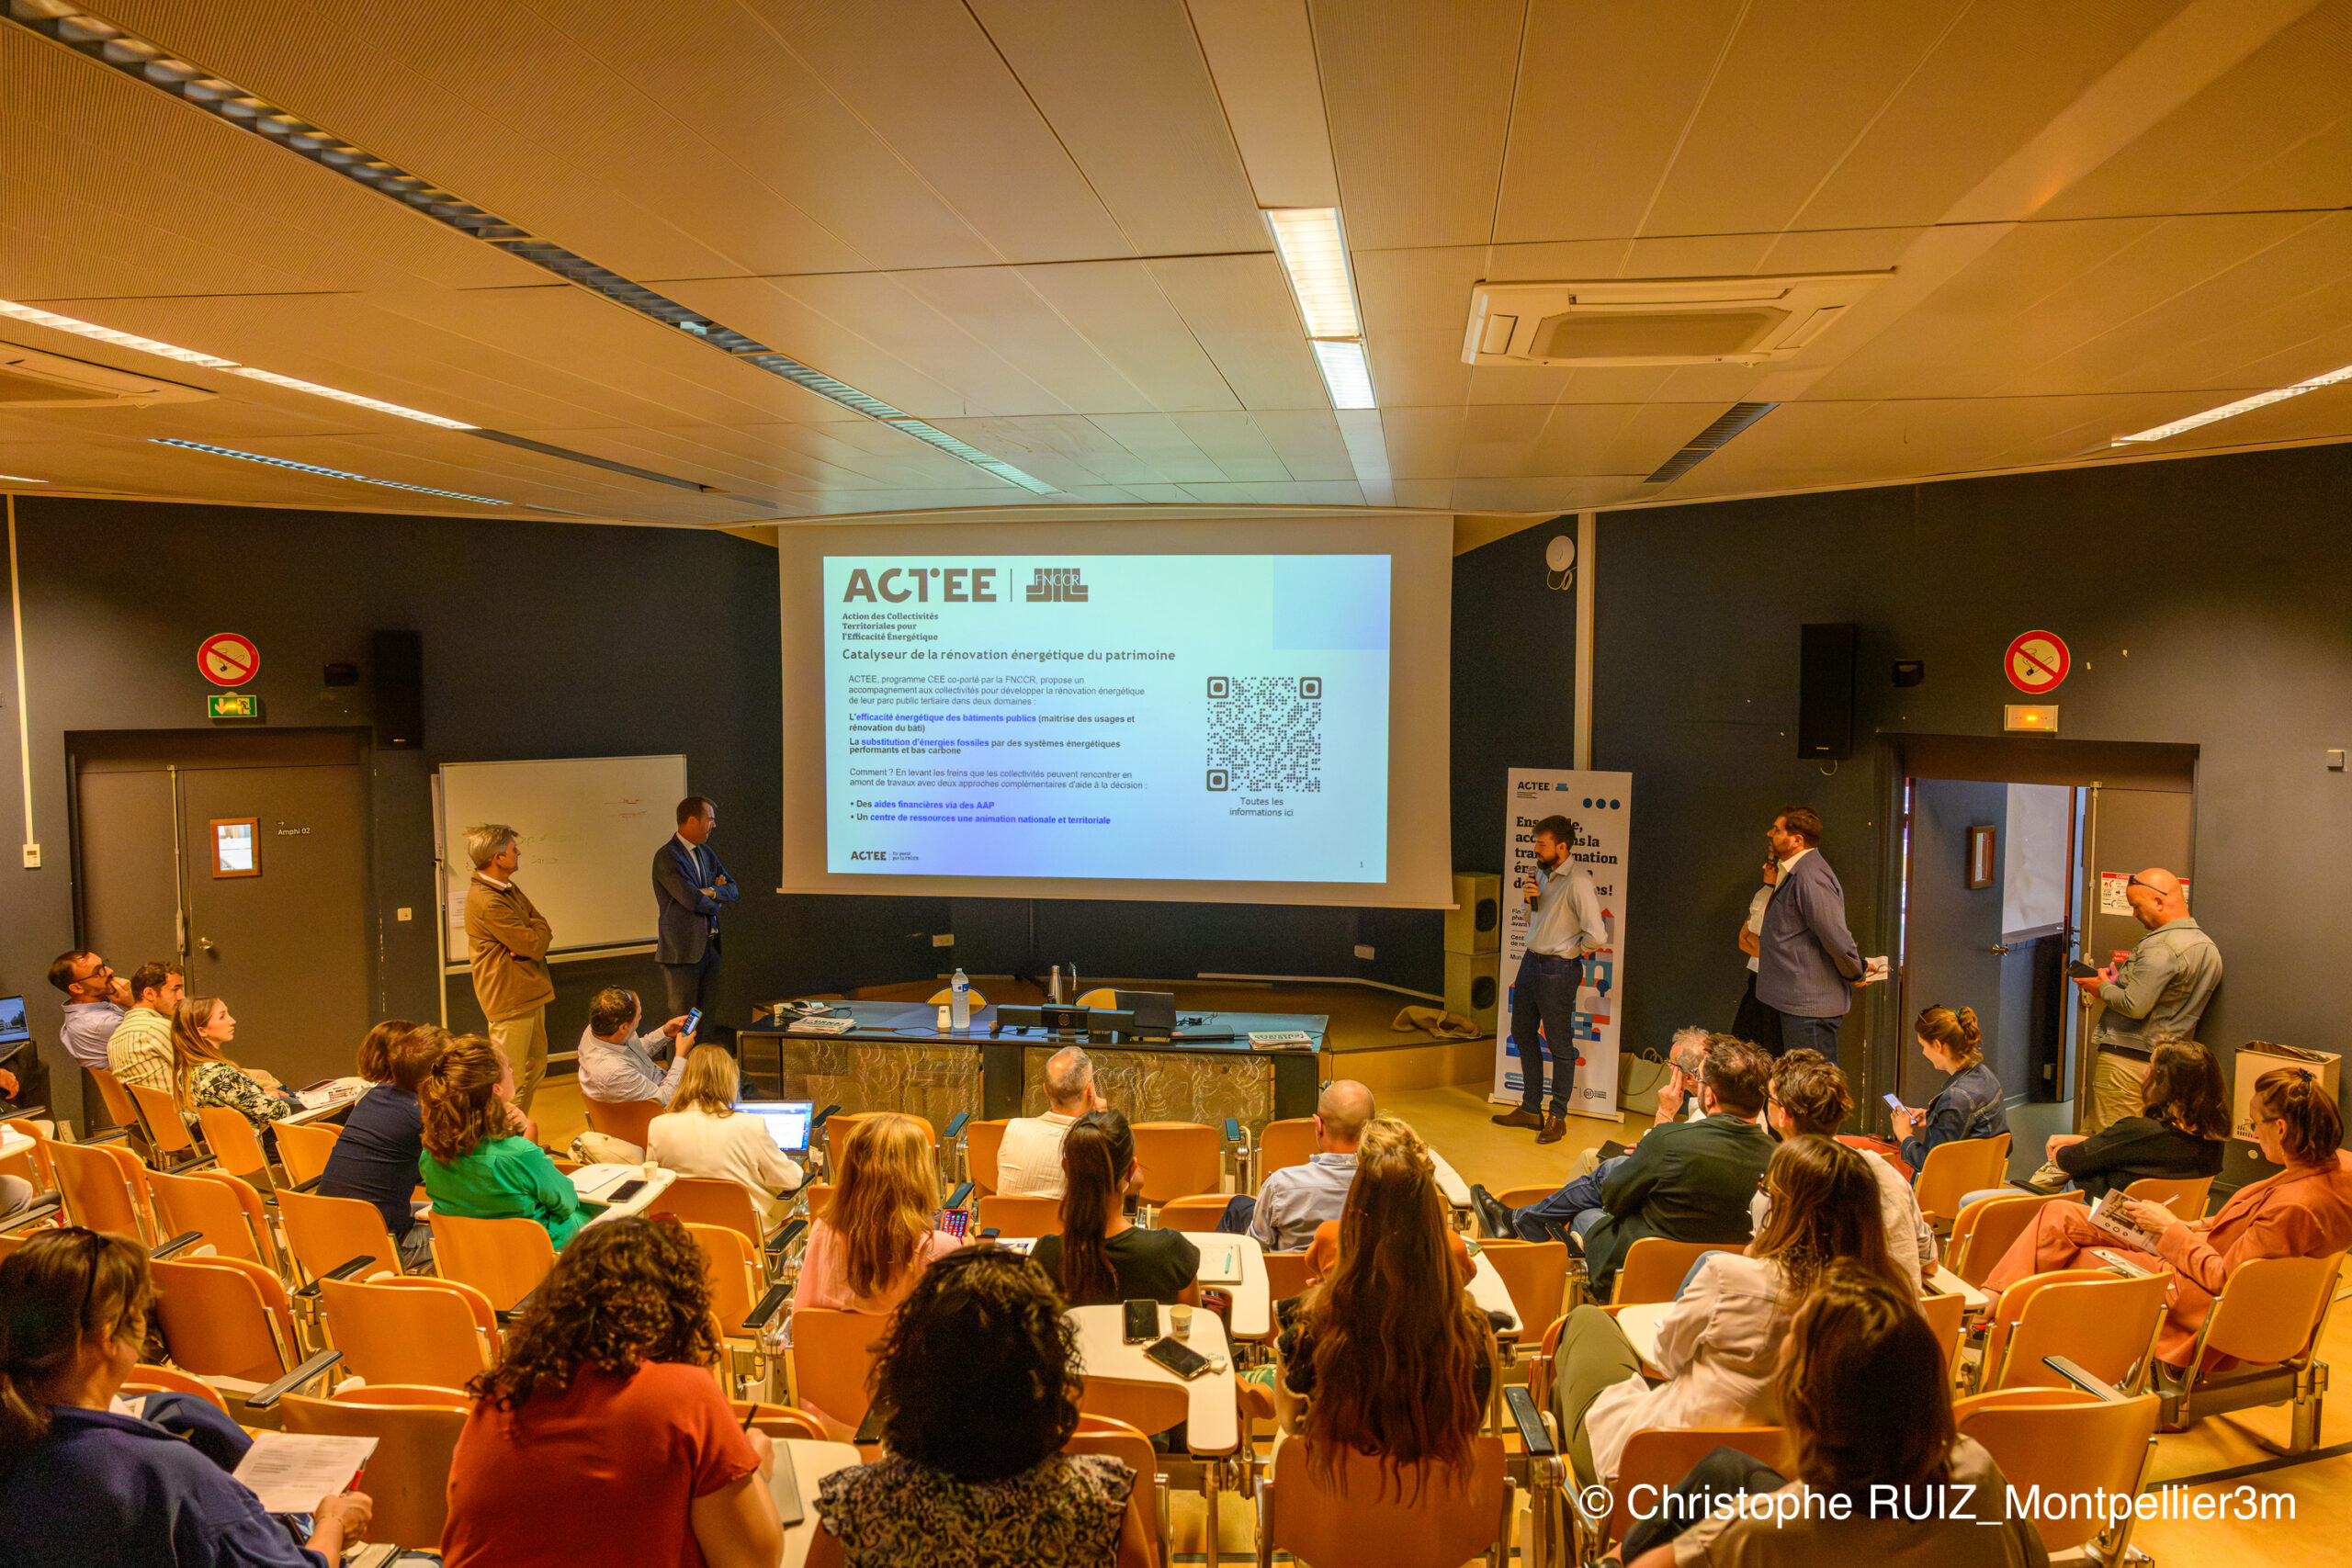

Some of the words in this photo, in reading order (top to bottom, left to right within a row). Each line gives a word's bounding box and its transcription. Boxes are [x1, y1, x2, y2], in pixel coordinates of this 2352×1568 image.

[843, 568, 997, 603] ACTEE
[1035, 573, 1080, 586] FNCCR
[897, 624, 917, 632] pour
[842, 632, 886, 640] l'Efficacité
[888, 632, 938, 642] Énergétique
[842, 649, 908, 661] Catalyseur
[910, 649, 924, 660] de
[927, 649, 938, 660] la
[941, 649, 1008, 660] rénovation
[1012, 649, 1084, 662] énergétique
[1087, 649, 1102, 660] du
[1106, 649, 1175, 662] patrimoine
[848, 675, 879, 685] ACTEE,
[881, 677, 925, 685] programme
[927, 675, 945, 683] CEE
[947, 675, 979, 685] co-porté
[981, 677, 994, 686] par
[996, 675, 1002, 683] la
[1005, 675, 1038, 686] FNCCR,
[1041, 677, 1072, 686] propose
[849, 686, 917, 696] accompagnement
[981, 688, 999, 696] pour
[1001, 687, 1045, 697] développer
[1055, 687, 1096, 695] rénovation
[1098, 687, 1145, 697] énergétique
[877, 698, 894, 706] parc
[896, 697, 919, 707] public
[921, 697, 950, 705] tertiaire
[951, 697, 970, 705] dans
[972, 697, 992, 705] deux
[994, 697, 1032, 705] domaines
[850, 713, 893, 721] L'efficacité
[895, 713, 944, 724] énergétique
[945, 714, 961, 722] des
[963, 714, 1004, 722] bâtiments
[1006, 714, 1036, 724] publics
[1126, 715, 1135, 723] et
[850, 724, 893, 732] rénovation
[895, 724, 905, 732] du
[908, 724, 924, 734] bâti)
[850, 738, 859, 746] La
[862, 738, 910, 746] substitution
[956, 739, 989, 747] fossiles
[991, 740, 1004, 749] par
[1007, 739, 1022, 747] des
[1024, 739, 1064, 749] systèmes
[1067, 739, 1121, 750] énergétiques
[850, 747, 899, 756] performants
[850, 768, 888, 776] Comment
[896, 768, 907, 776] En
[946, 769, 968, 777] freins
[969, 771, 985, 779] que
[987, 769, 998, 777] les
[1046, 770, 1078, 780] peuvent
[1080, 770, 1121, 778] rencontrer
[958, 780, 999, 789] approches
[1001, 780, 1067, 790] complémentaires
[1102, 781, 1108, 789] la
[1517, 782, 1550, 791] ACTEE
[856, 800, 872, 808] Des
[874, 800, 896, 808] aides
[898, 800, 944, 808] financières
[945, 801, 957, 809] via
[959, 801, 974, 809] des
[977, 801, 994, 809] AAP
[1240, 796, 1269, 806] Toutes
[1272, 796, 1283, 806] les
[1229, 807, 1282, 817] informations
[1284, 807, 1294, 817] ici
[857, 813, 868, 821] Un
[870, 813, 896, 821] centre
[898, 814, 908, 822] de
[975, 815, 1015, 823] animation
[1018, 815, 1056, 823] nationale
[1057, 816, 1066, 824] et
[1068, 816, 1111, 824] territoriale
[1588, 835, 1600, 847] la
[851, 851, 887, 861] ACTEE
